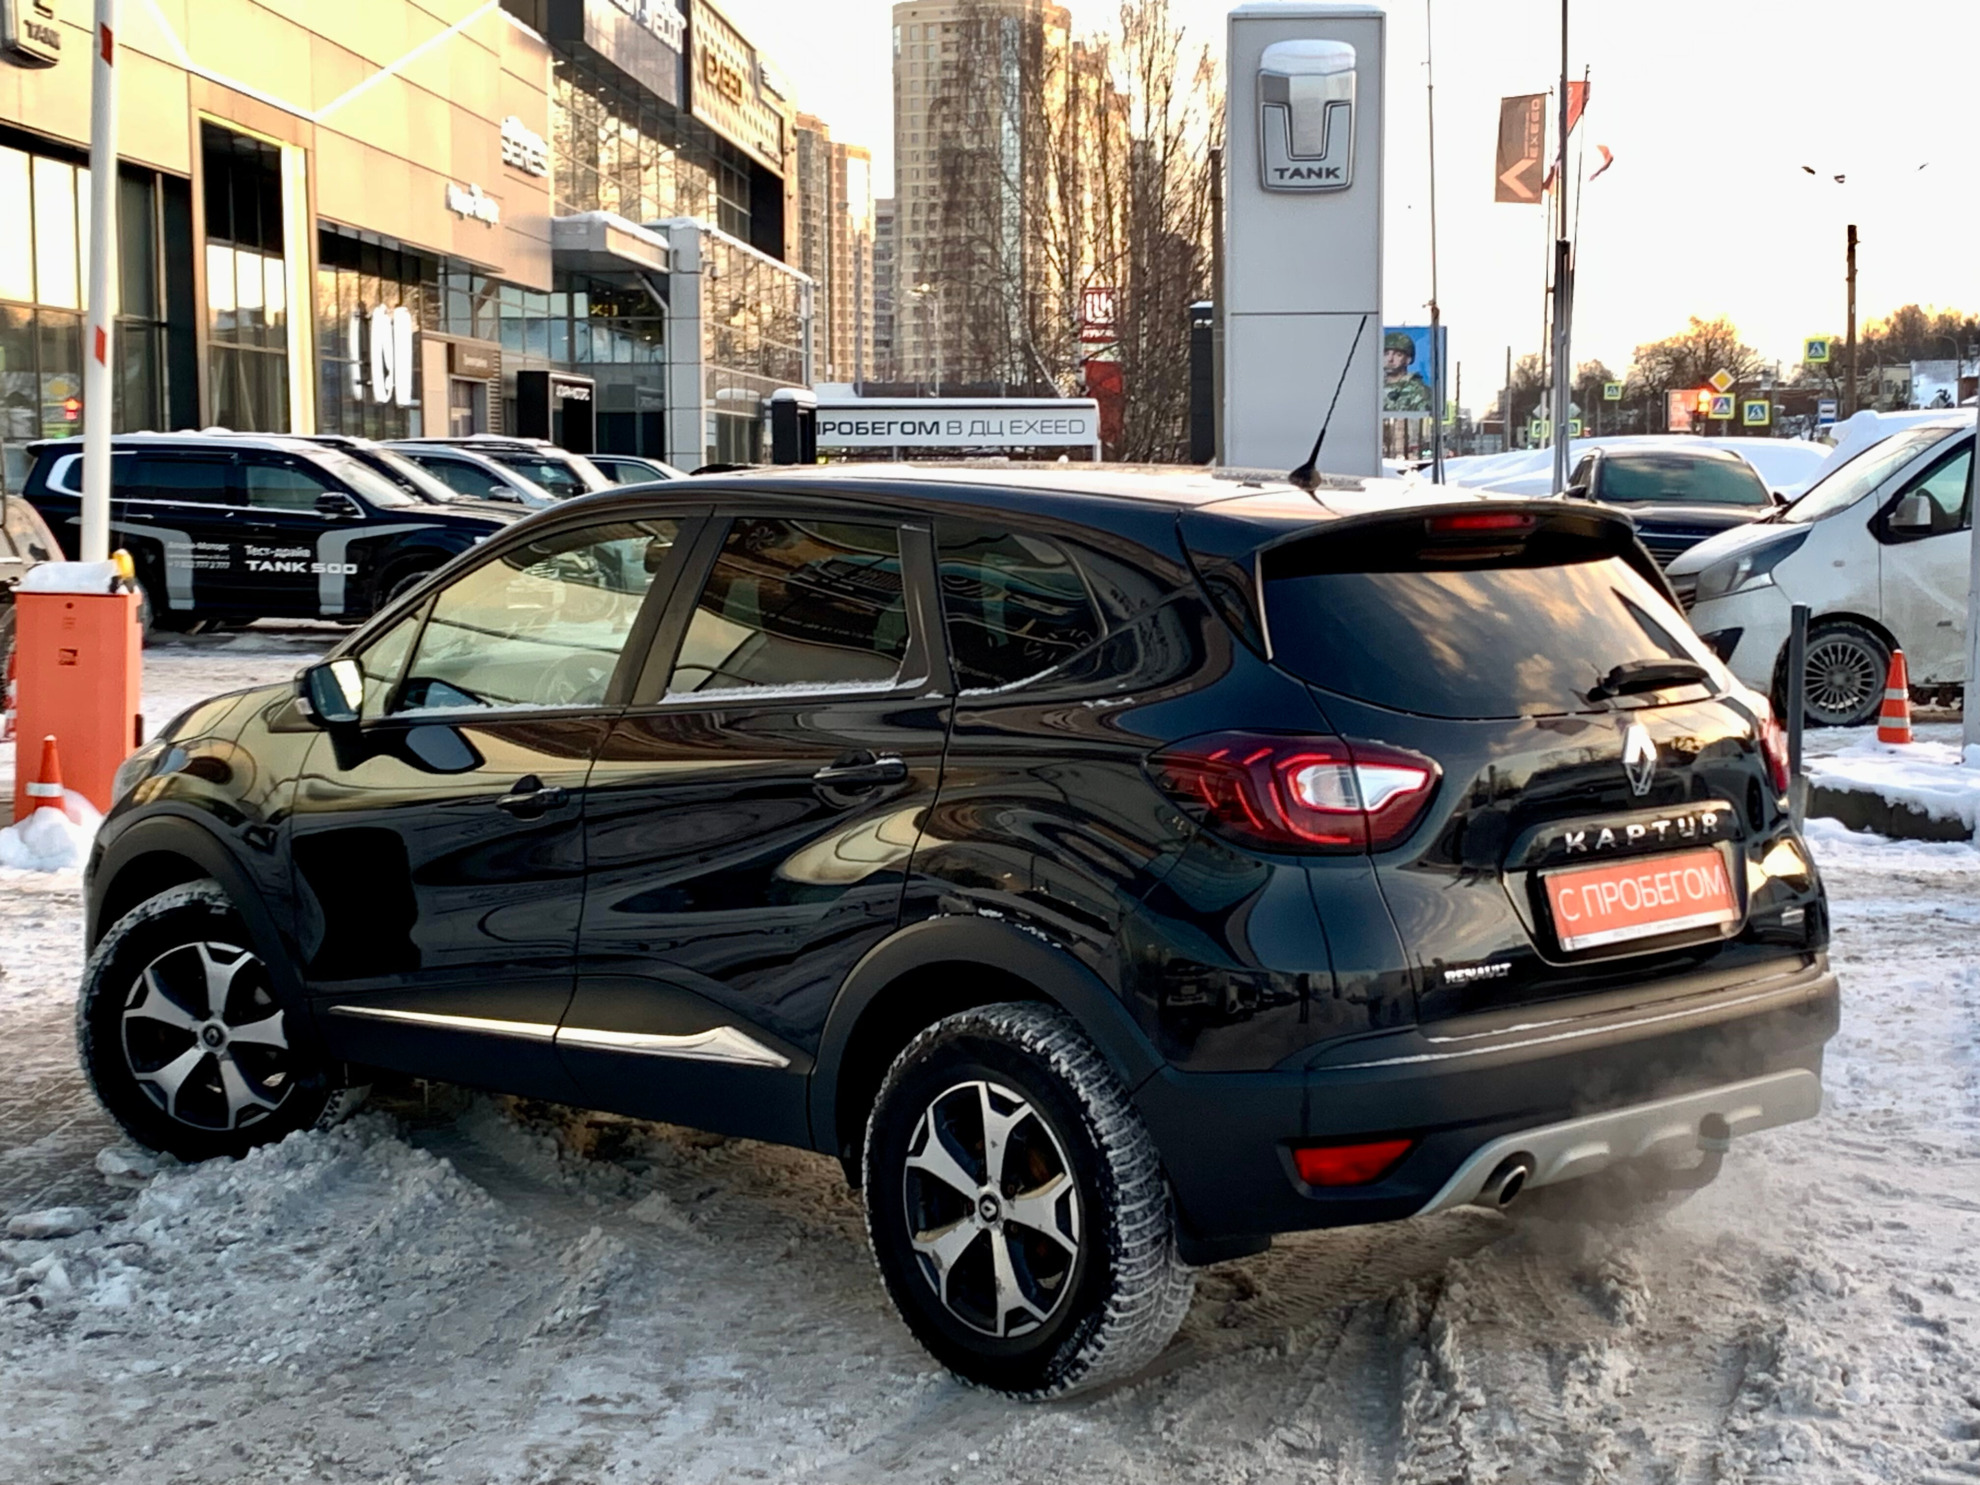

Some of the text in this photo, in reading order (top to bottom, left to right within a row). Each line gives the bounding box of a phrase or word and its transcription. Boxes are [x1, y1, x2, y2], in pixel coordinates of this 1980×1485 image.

[1273, 166, 1341, 181] TANK
[946, 420, 963, 436] В
[968, 420, 1004, 438] ДЦ
[1009, 419, 1086, 435] EXEED
[244, 560, 358, 575] TANK 500
[1565, 813, 1718, 854] KAPTUR
[1558, 865, 1727, 922] С ПРОБЕГОМ
[1444, 962, 1512, 984] RENAULT
